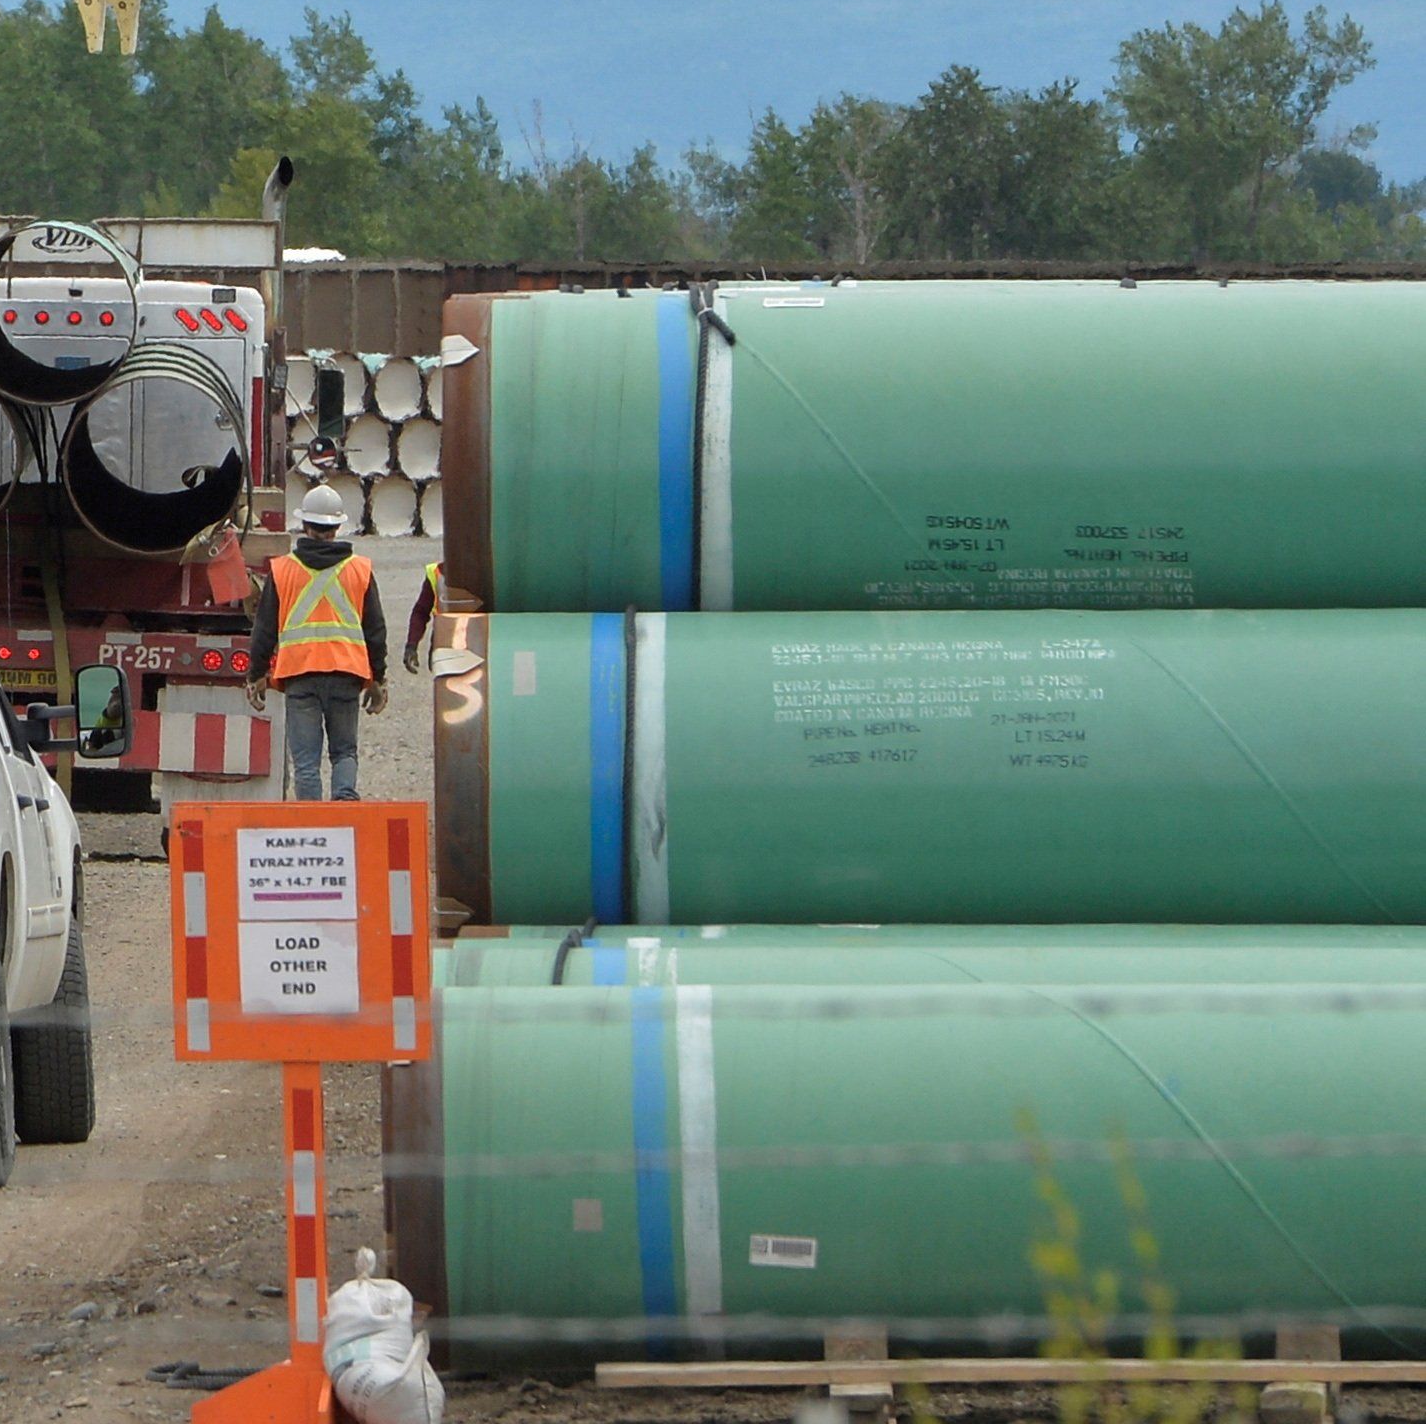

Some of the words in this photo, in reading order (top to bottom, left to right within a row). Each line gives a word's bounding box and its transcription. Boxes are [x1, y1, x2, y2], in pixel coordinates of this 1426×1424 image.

[983, 517, 1009, 530] WT
[985, 539, 1004, 550] LT
[772, 643, 821, 653] EVRAZ
[827, 643, 863, 652] MADE
[888, 641, 946, 651] CANADA
[99, 644, 175, 670] PT-257
[773, 680, 821, 692] EVRAZ
[1014, 730, 1033, 742] LT
[1010, 754, 1034, 768] WT
[266, 837, 328, 848] KAM-F-42
[249, 858, 294, 868] EVRAZ
[297, 857, 345, 867] NTP2-2
[286, 877, 313, 887] 14.7
[321, 876, 347, 886] FBE
[275, 937, 320, 951] LOAD
[270, 960, 328, 973] OTHER
[282, 982, 317, 995] END
